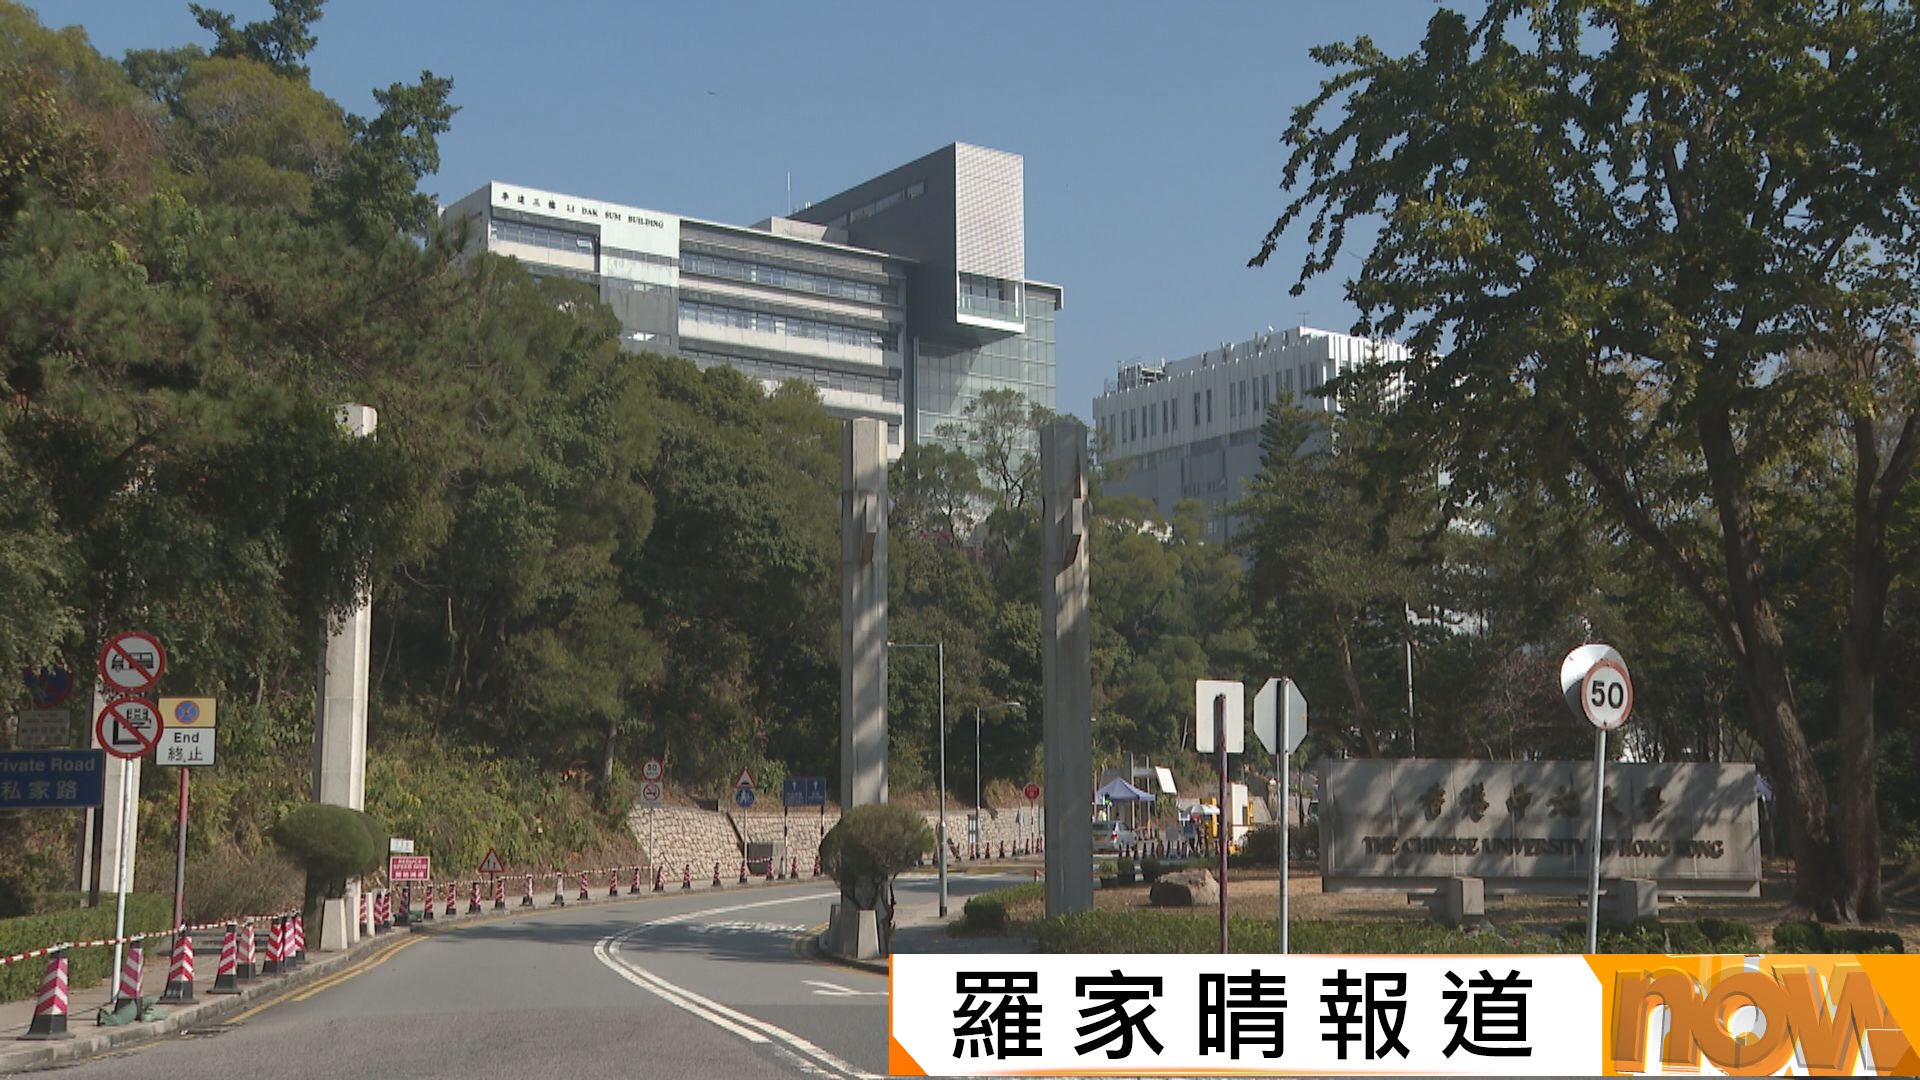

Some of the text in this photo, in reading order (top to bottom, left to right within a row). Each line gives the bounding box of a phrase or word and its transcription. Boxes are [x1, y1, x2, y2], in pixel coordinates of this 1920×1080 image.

[581, 206, 599, 217] DAK
[605, 210, 622, 221] SUM
[628, 215, 664, 230] BUILDING
[1591, 680, 1624, 709] 50
[174, 731, 200, 743] End
[167, 746, 203, 763] 終止
[0, 757, 95, 772] rivate Road
[1, 780, 78, 800] 私家路
[1618, 839, 1670, 858] HONG
